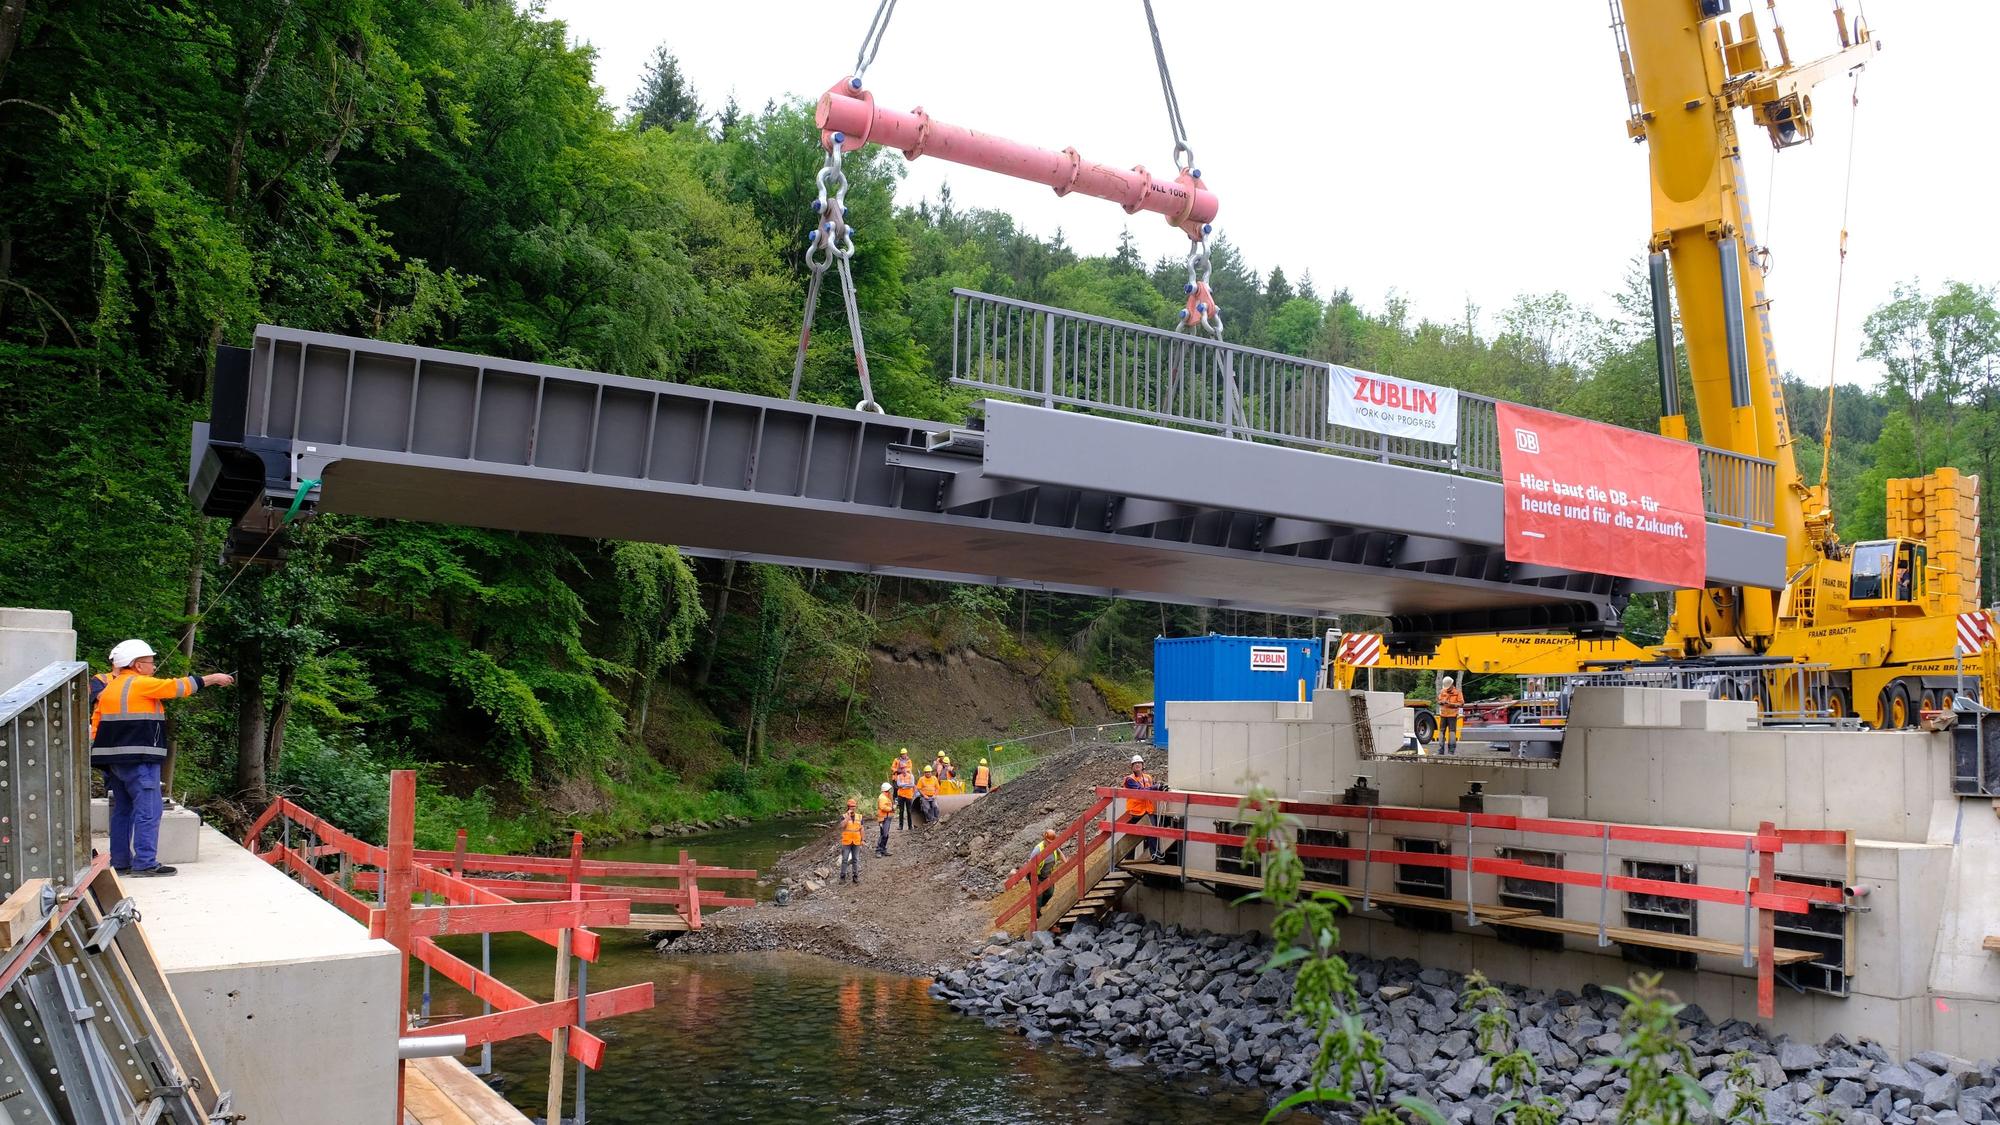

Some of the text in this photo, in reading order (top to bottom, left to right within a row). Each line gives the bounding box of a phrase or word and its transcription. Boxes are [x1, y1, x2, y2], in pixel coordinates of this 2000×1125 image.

[1353, 376, 1437, 415] ZÜBLIN
[1381, 412, 1395, 421] ON
[1397, 415, 1436, 429] PROGRESS
[1518, 433, 1537, 450] DB
[1519, 472, 1550, 492] Hier
[1552, 480, 1585, 499] baut
[1586, 486, 1607, 503] die
[1609, 489, 1628, 507] DB
[1641, 495, 1660, 513] für
[1521, 494, 1688, 539] heute und für die Zukunft.
[1808, 629, 1827, 638] FRANZ
[1828, 626, 1852, 636] BRACHT
[1501, 637, 1531, 645] FRANZ
